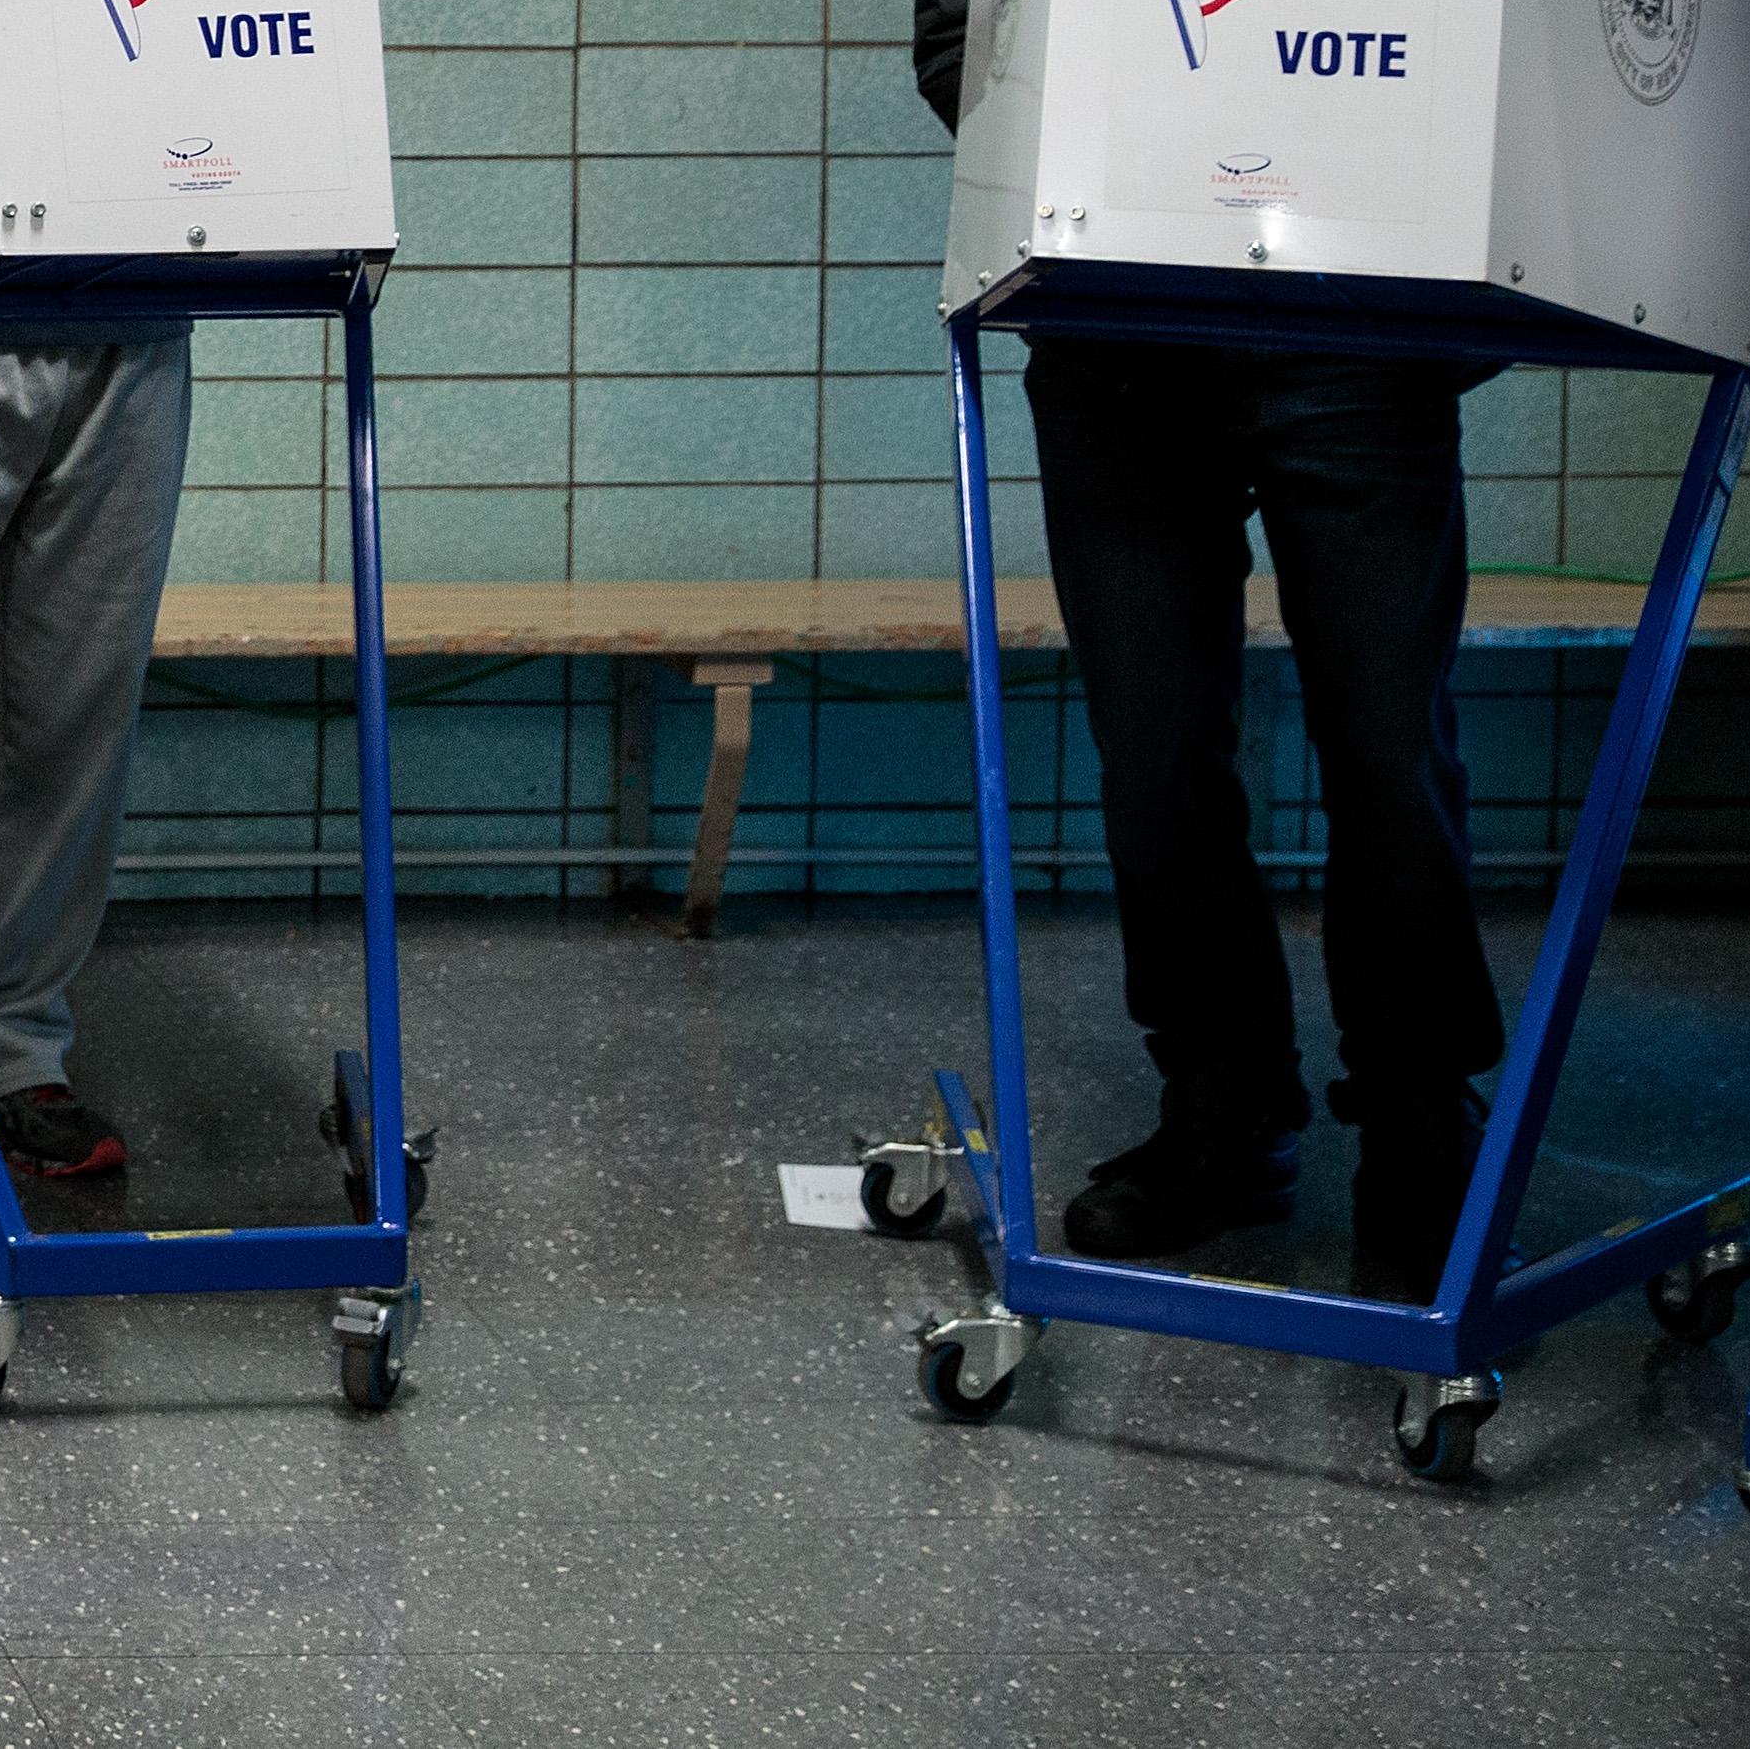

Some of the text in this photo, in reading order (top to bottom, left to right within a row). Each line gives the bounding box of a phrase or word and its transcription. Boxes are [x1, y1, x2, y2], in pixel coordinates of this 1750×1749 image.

[197, 11, 316, 59] VOTE
[1275, 30, 1407, 78] VOTE
[162, 156, 234, 169] SMARTPOLL
